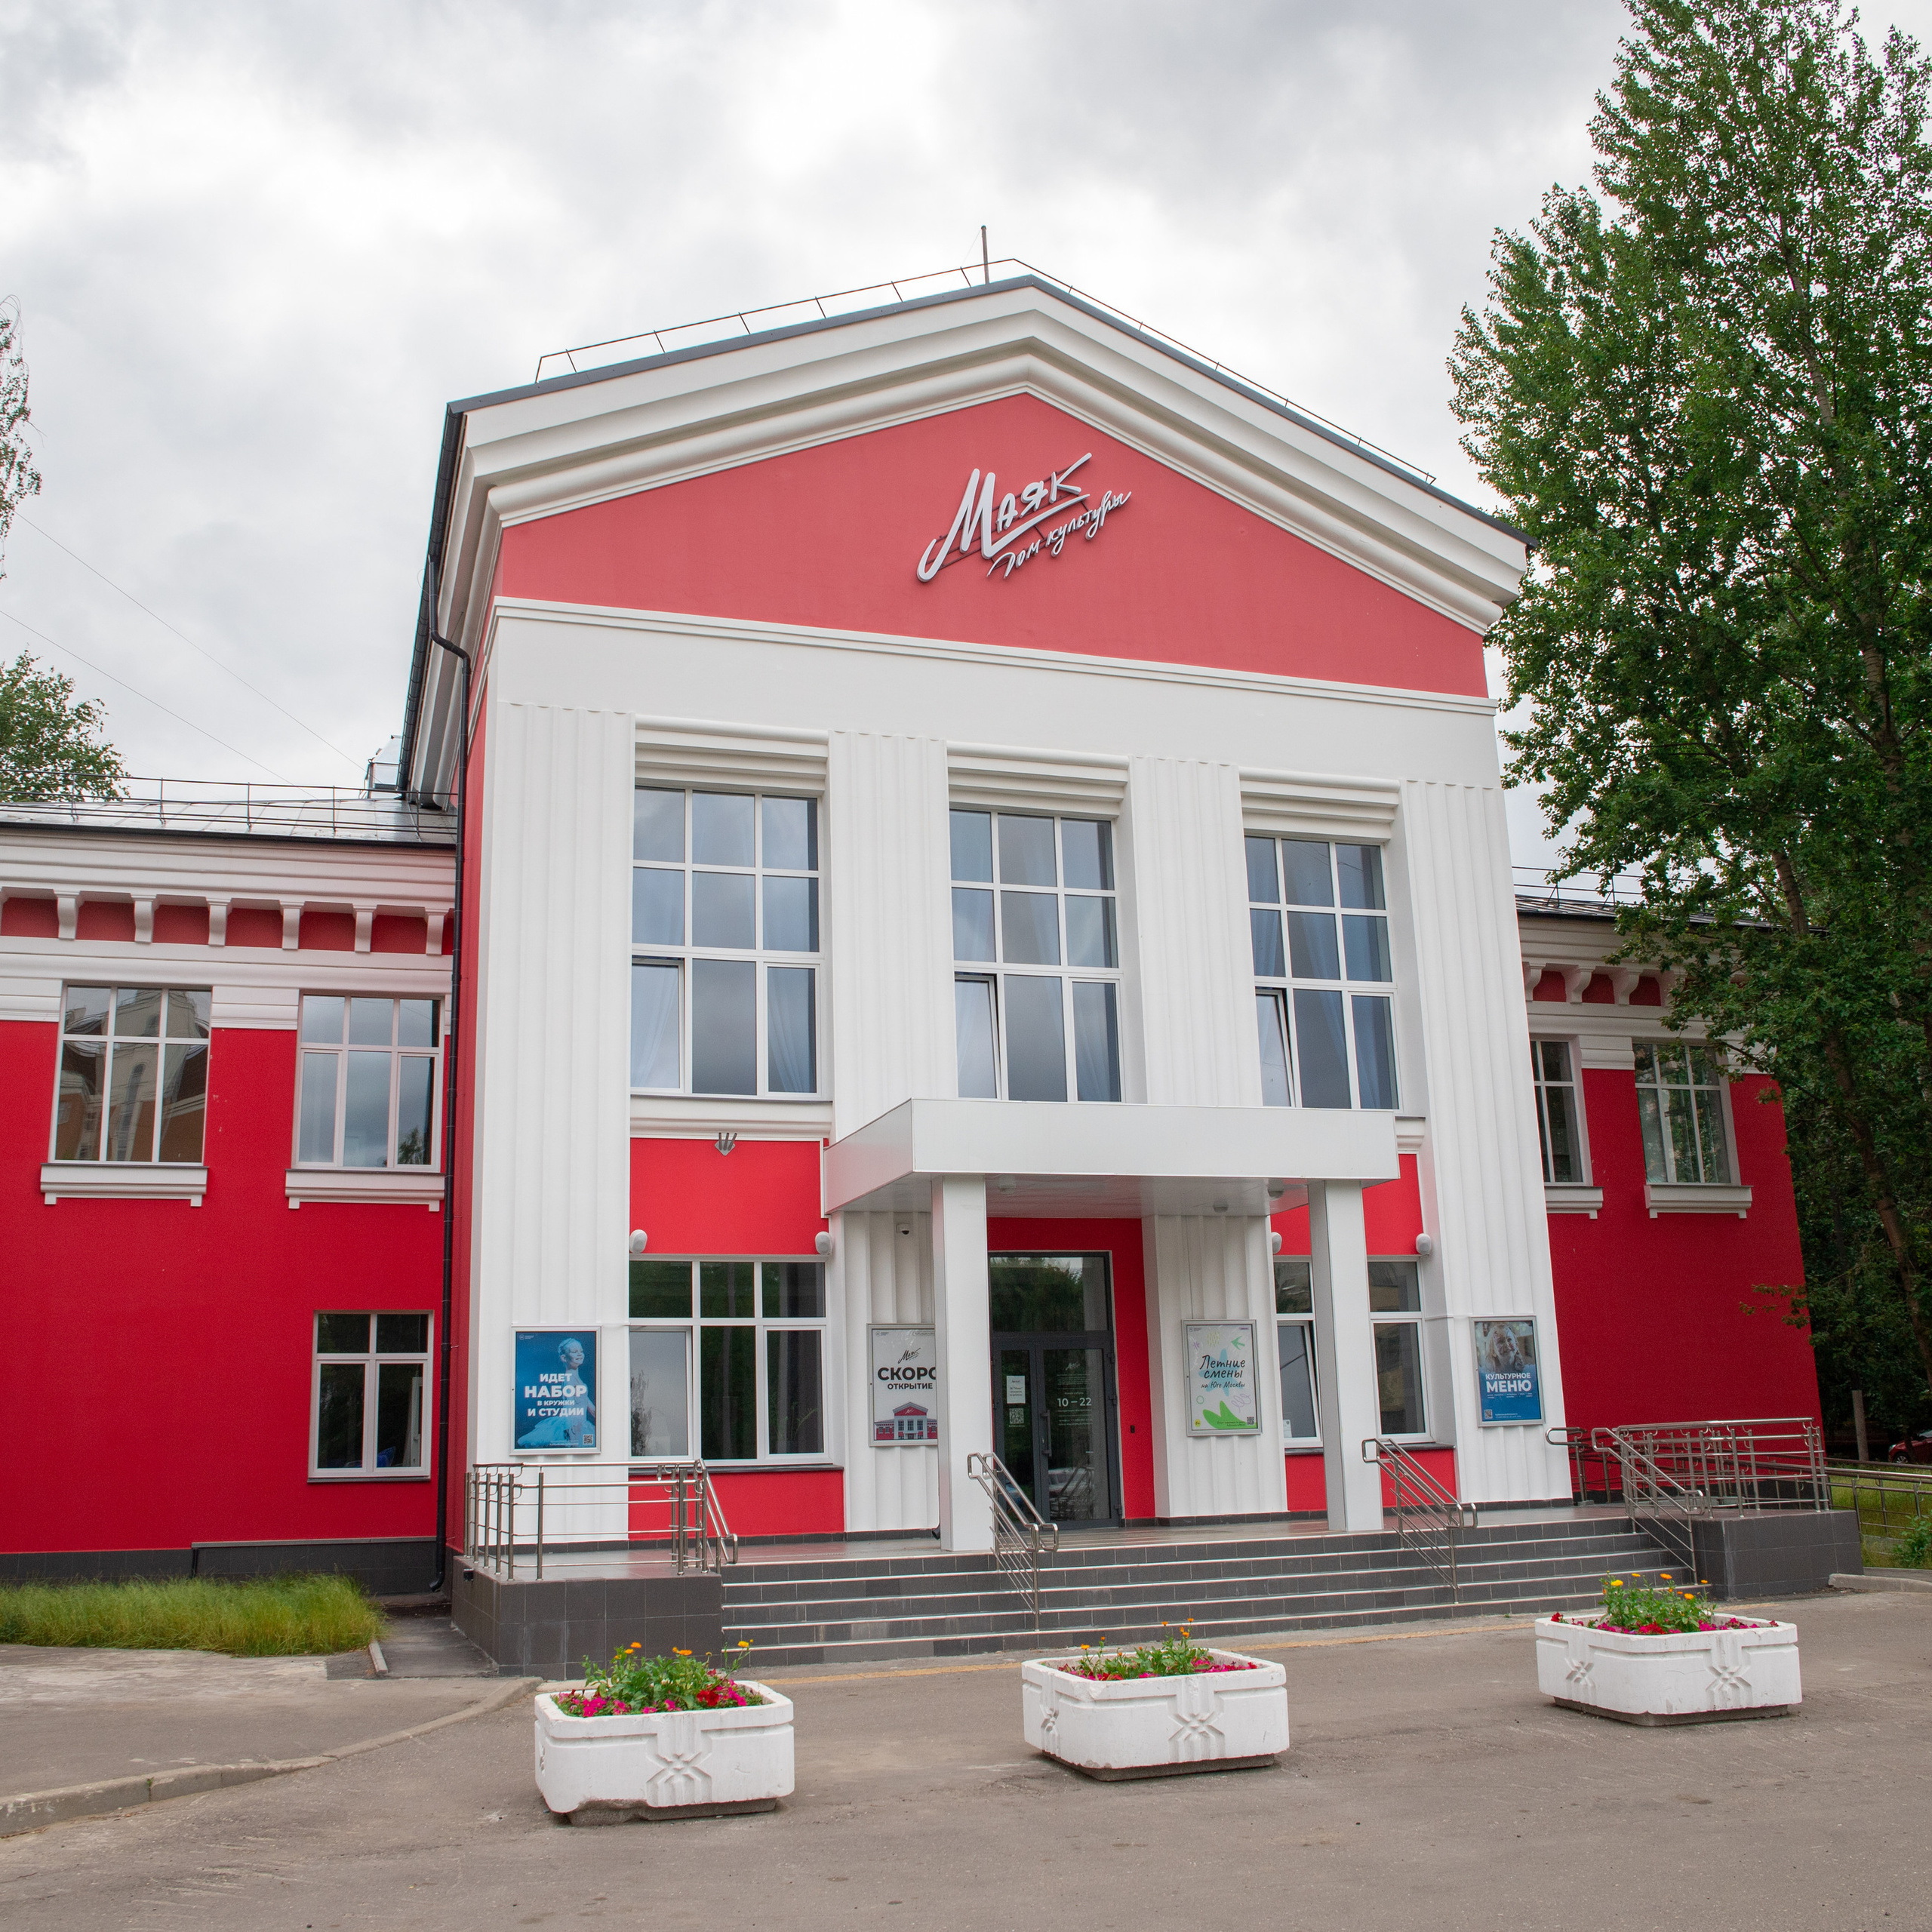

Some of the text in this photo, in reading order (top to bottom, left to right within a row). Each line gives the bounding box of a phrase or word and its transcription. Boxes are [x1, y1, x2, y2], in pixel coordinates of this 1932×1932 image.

[986, 490, 1132, 580] Дом культуры
[1199, 1354, 1246, 1370] Летние
[540, 1374, 572, 1383] ИДЕТ
[1204, 1370, 1243, 1379] смены
[1485, 1372, 1531, 1380] КУЛЬТУРНОЕ
[525, 1385, 587, 1398] НАБОР
[1486, 1380, 1532, 1393] МЕНЮ
[1057, 1398, 1069, 1407] 10
[1079, 1397, 1092, 1406] 22
[528, 1407, 585, 1417] И СТУДИИ
